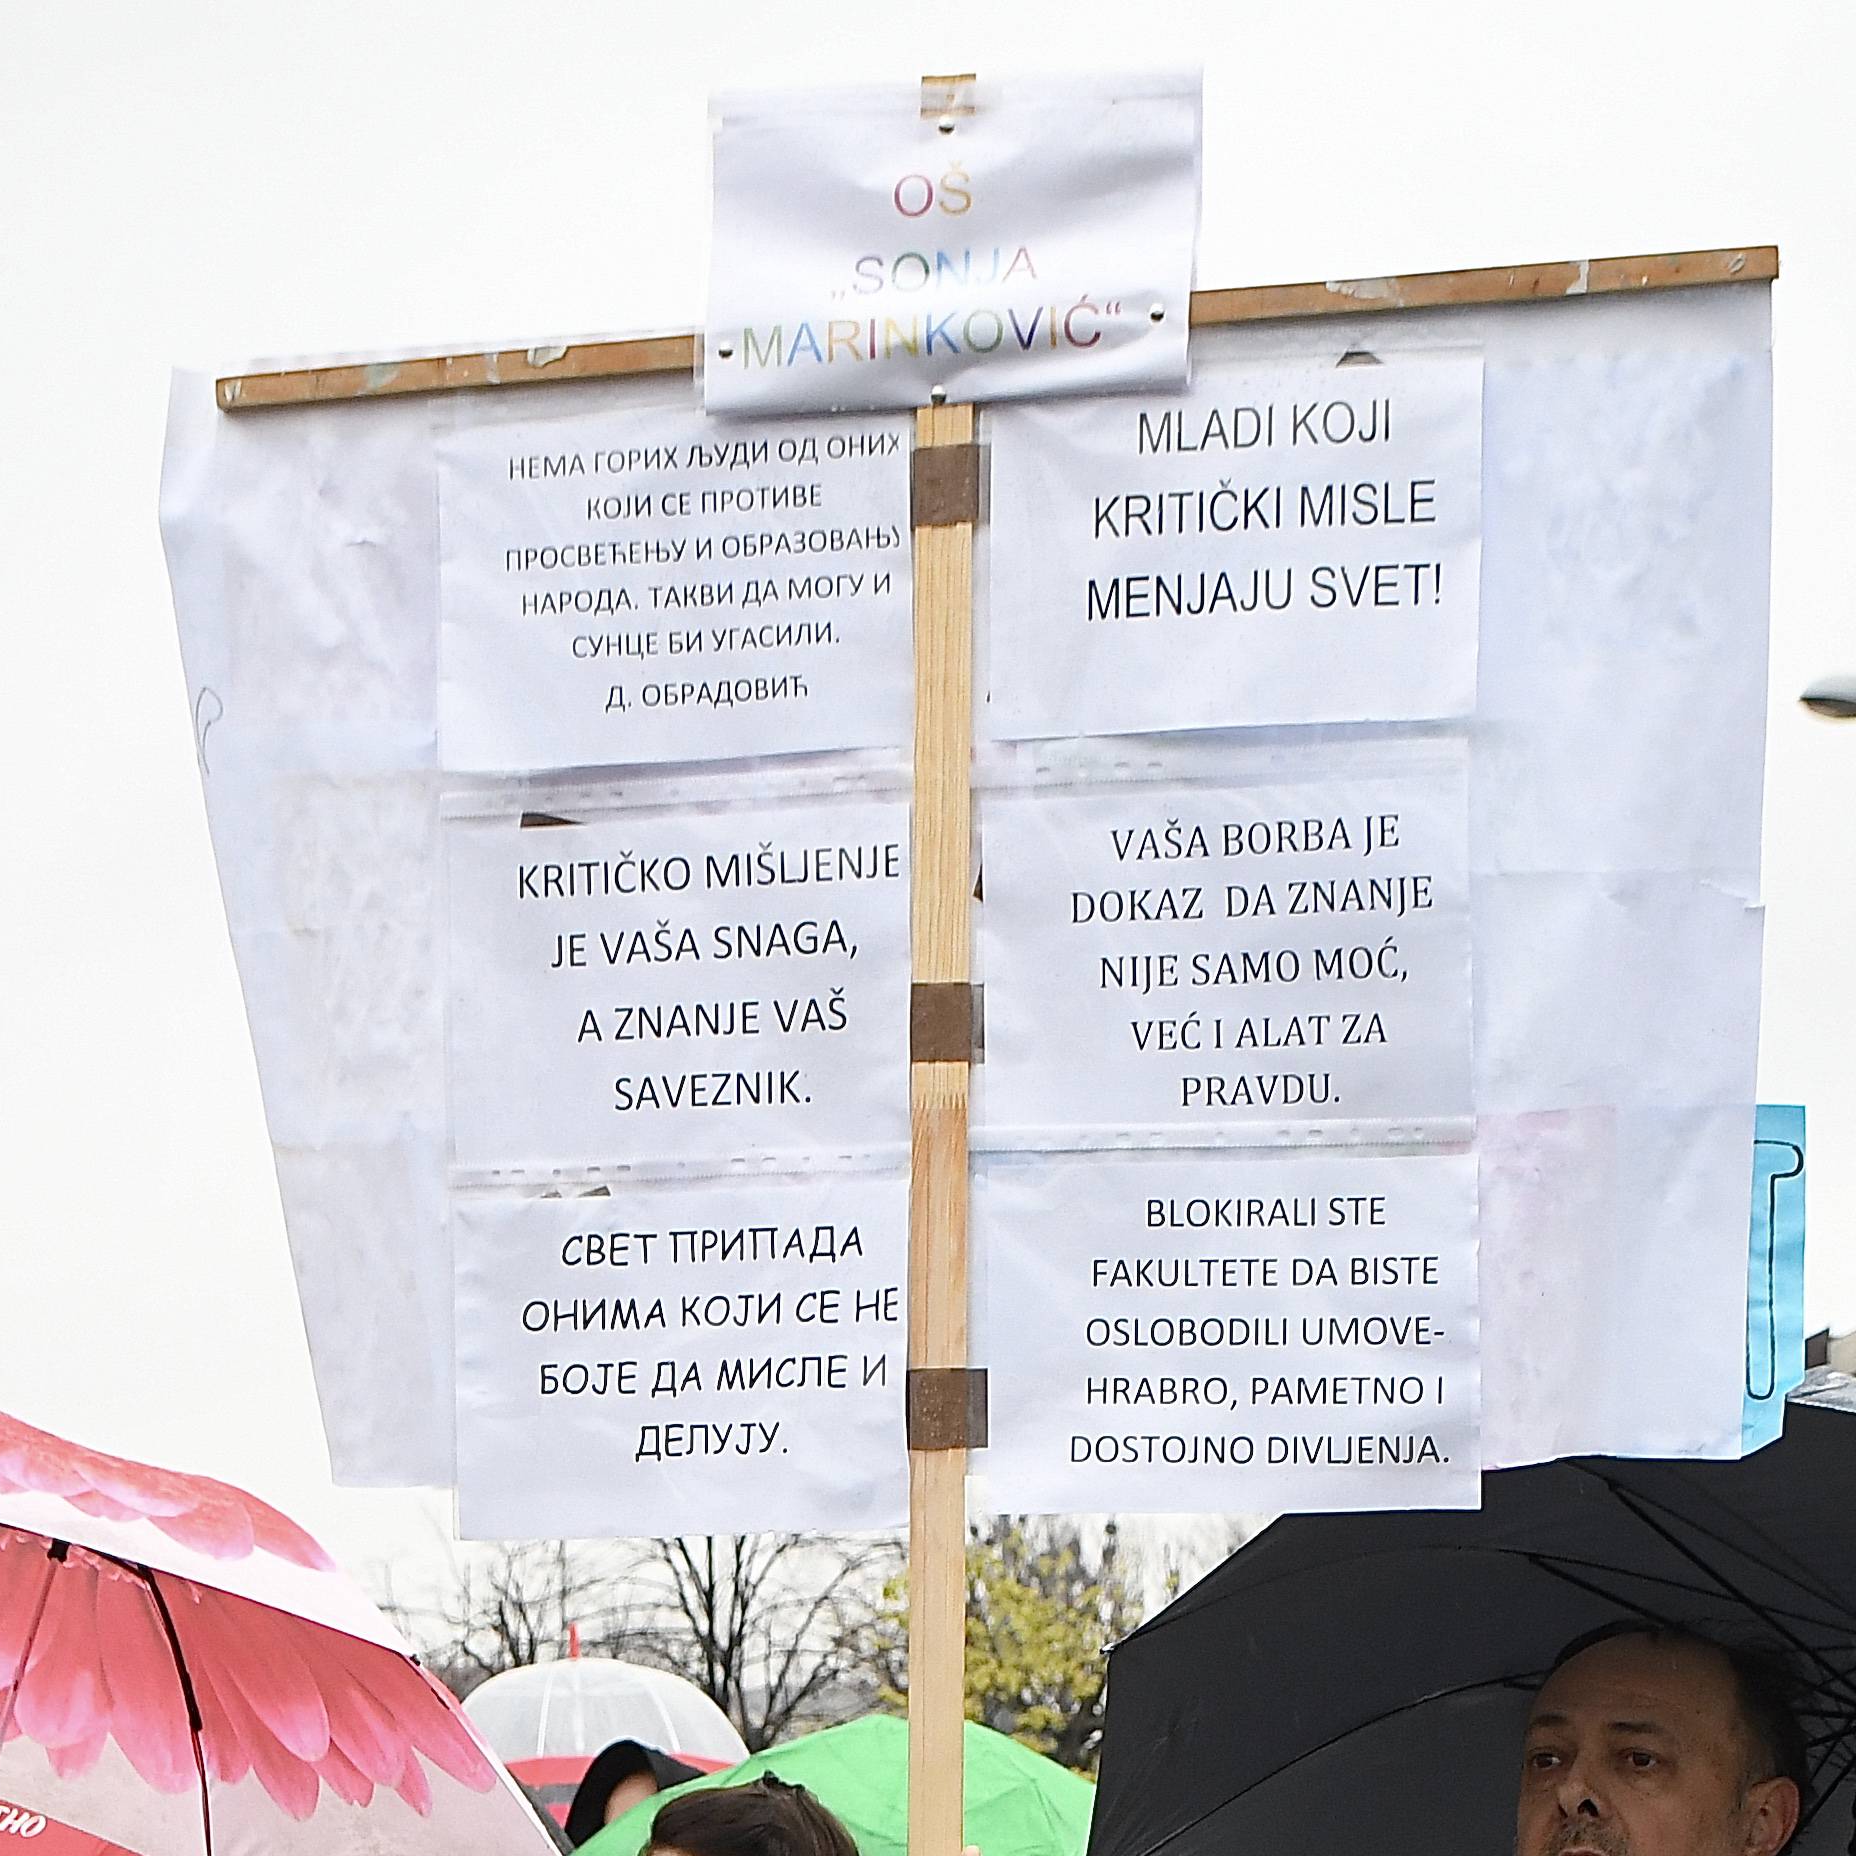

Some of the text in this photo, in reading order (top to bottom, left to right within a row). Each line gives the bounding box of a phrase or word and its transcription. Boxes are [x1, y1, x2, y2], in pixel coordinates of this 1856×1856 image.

[894, 163, 972, 218] OŠ
[1139, 398, 1389, 455] MLADI KOJI
[510, 433, 898, 481] НЕМА ГОРИХ ЉУДИ ОД ОНИХ
[588, 484, 821, 520] КОЈИ СЕ ПРОТИВЕ
[1095, 477, 1436, 540] KRITIČKI MISLE
[507, 538, 686, 572] ПРОСВЕЋЕЊУ
[696, 537, 711, 560] И
[648, 581, 733, 609] ТАКВИ
[742, 579, 778, 609] ДА
[789, 573, 864, 600] МОГУ
[874, 571, 890, 595] И
[1088, 562, 1440, 622] MENJAJU SVET!
[573, 621, 839, 660] СУНЦЕ БИ УГАСИЛИ.
[605, 674, 807, 714] Д. ОБРАДОВИЋ
[1110, 814, 1399, 861] VAŠA BORBA JE
[520, 841, 899, 899] KRITIČKO MIŠLJENJE
[1072, 875, 1432, 923] DOKAZ DA ZNANJE
[551, 919, 857, 968] JE VAŠA SNAGA,
[1101, 936, 1407, 995] NIJE SAMO MOĆ,
[578, 987, 846, 1043] A ZNANJE VAŠ
[1131, 1011, 1387, 1051] VEĆ I ALAT ZA
[615, 1070, 810, 1110] SAVEZNIK.
[1182, 1073, 1339, 1106] PRAVDU.
[1148, 1197, 1385, 1227] BLOKIRALI STE
[562, 1225, 862, 1266] СВЕТ ПРИПАДА
[1093, 1256, 1438, 1287] FAKULTETE DA BISTE
[523, 1287, 898, 1333] ОНИМА КОЈИ СЕ НЕ
[1087, 1316, 1444, 1346] OSLOBODILI UMOVE-
[541, 1354, 886, 1398] БОЈЕ ДА МИСЛЕ И
[1088, 1376, 1442, 1411] HRABRO, PAMETNO I
[635, 1421, 787, 1462] ДЕЛУЈУ.
[1071, 1436, 1449, 1464] DOSTOJNO DIVLJENJA.
